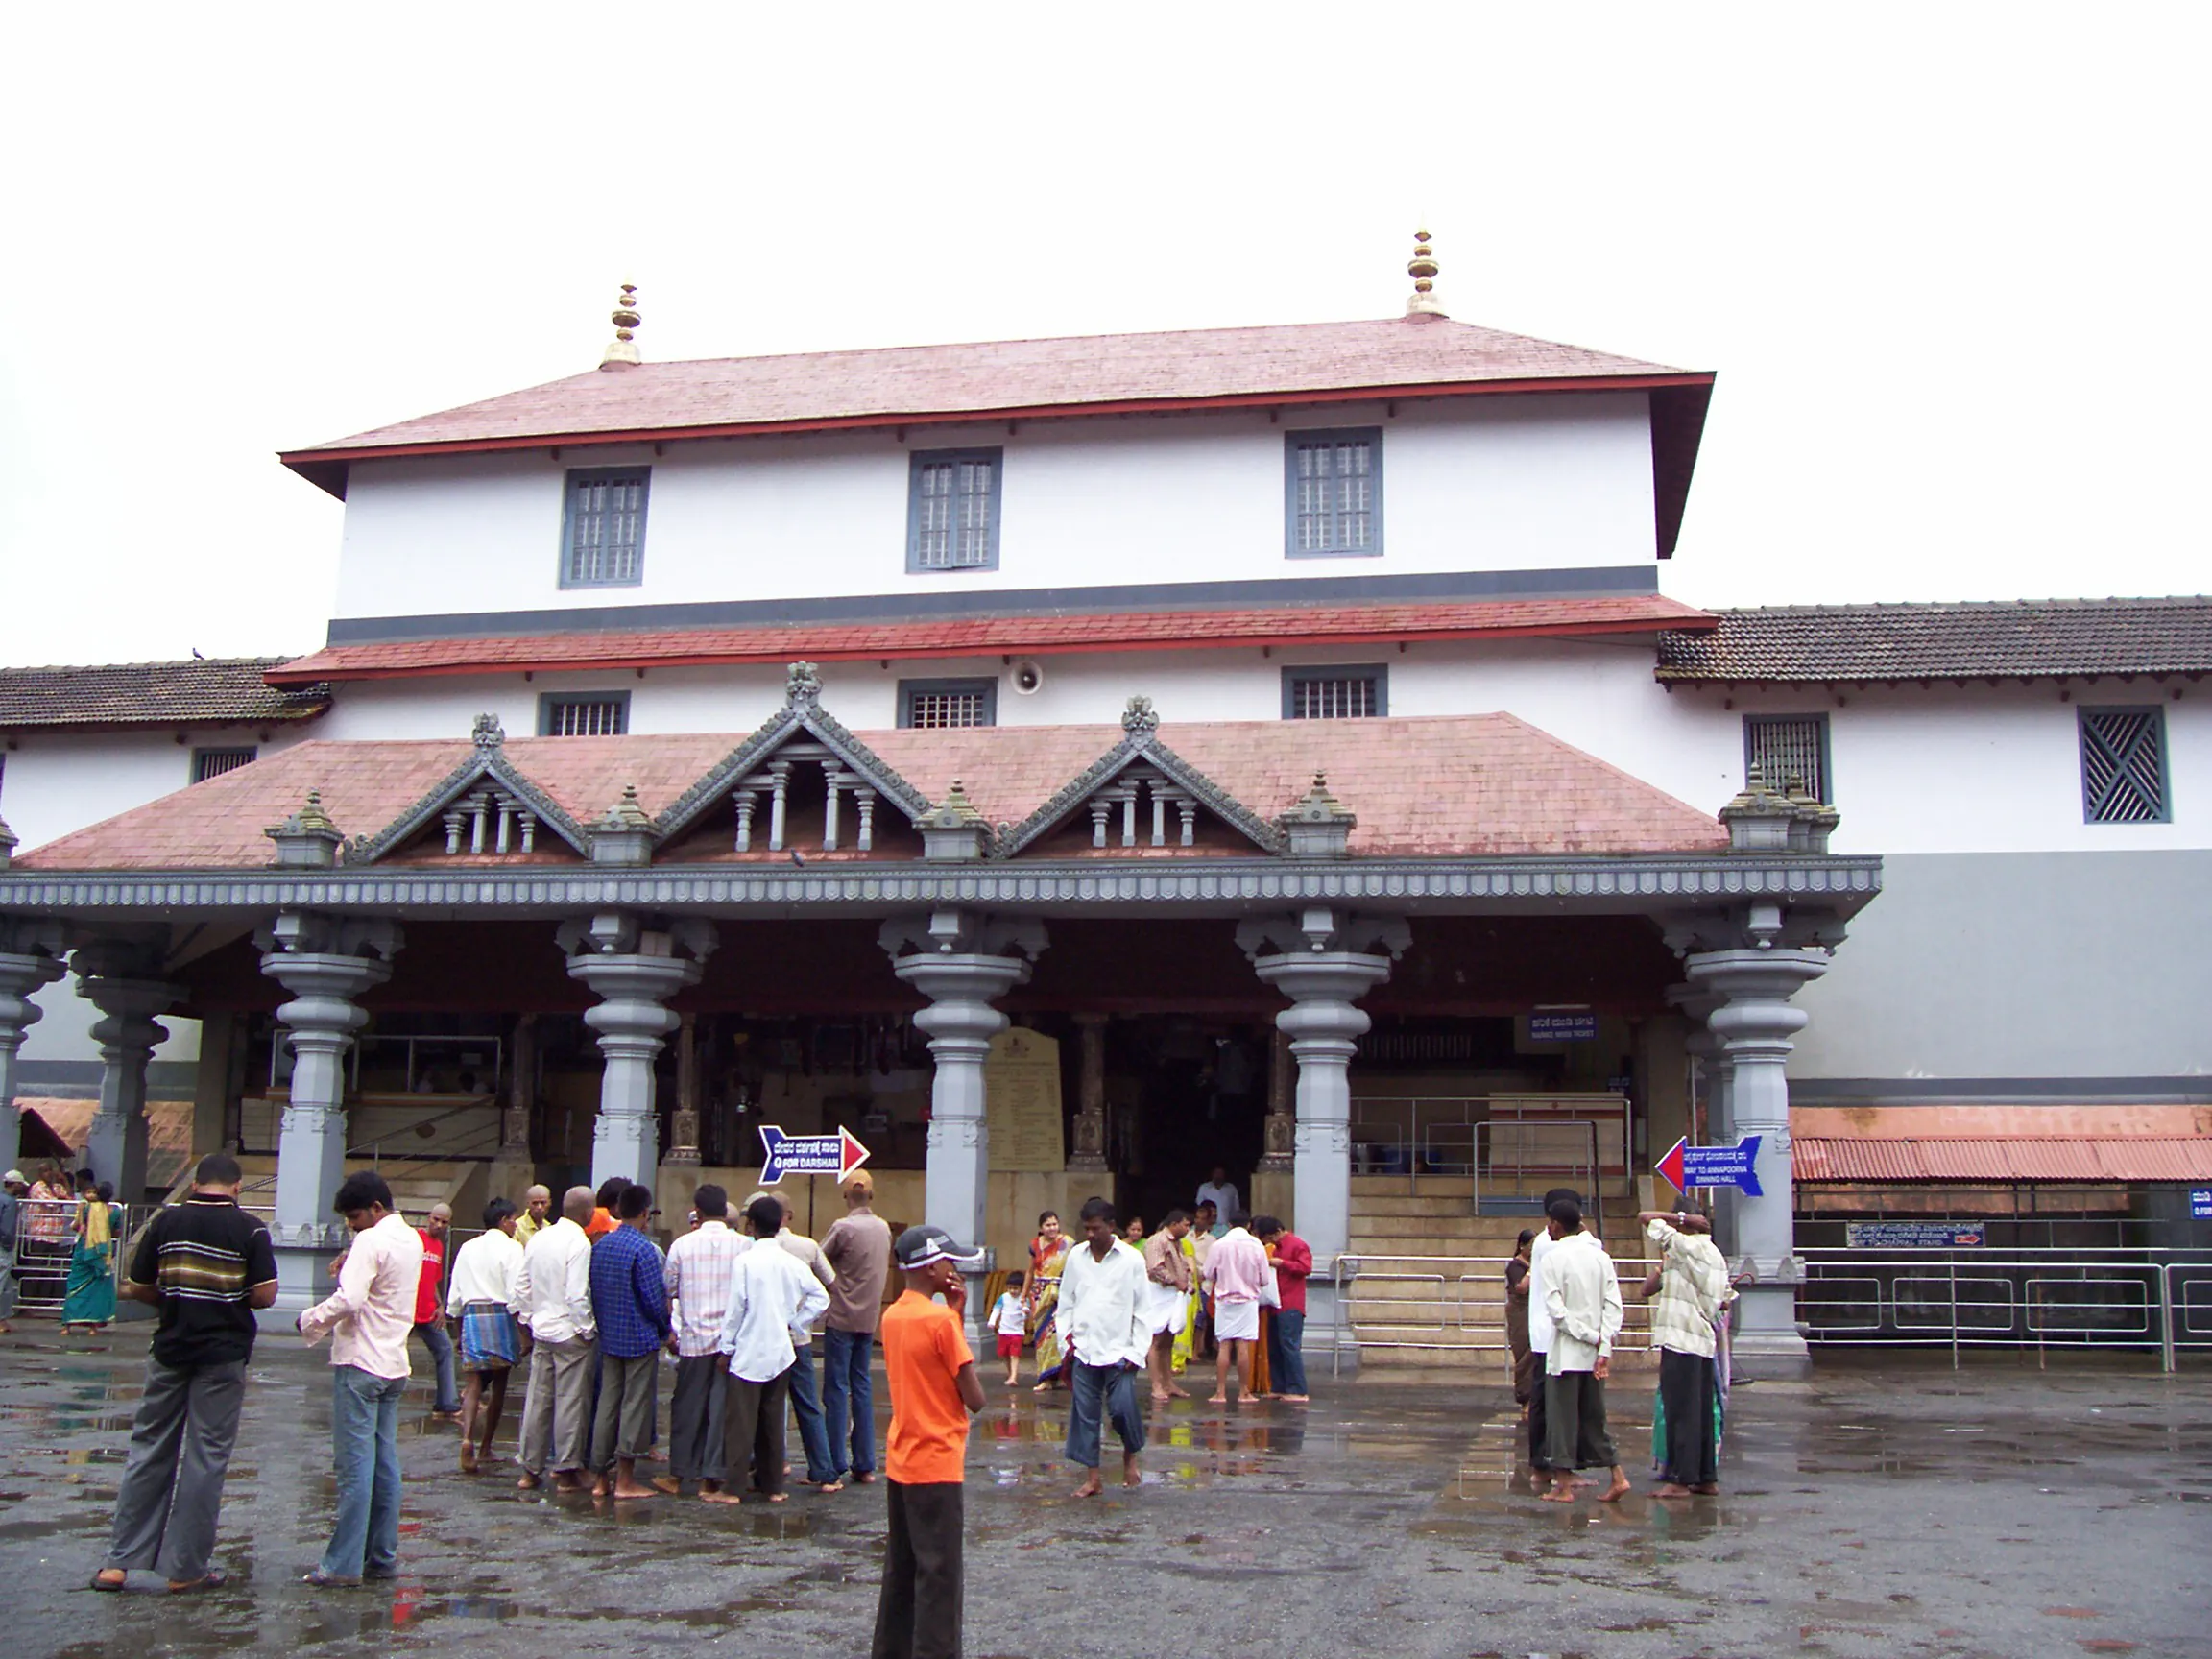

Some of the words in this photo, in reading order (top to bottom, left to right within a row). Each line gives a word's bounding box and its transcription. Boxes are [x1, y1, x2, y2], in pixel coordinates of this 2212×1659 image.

[774, 1156, 782, 1168] Q
[782, 1158, 799, 1168] FOR
[800, 1157, 839, 1168] DARSHAN
